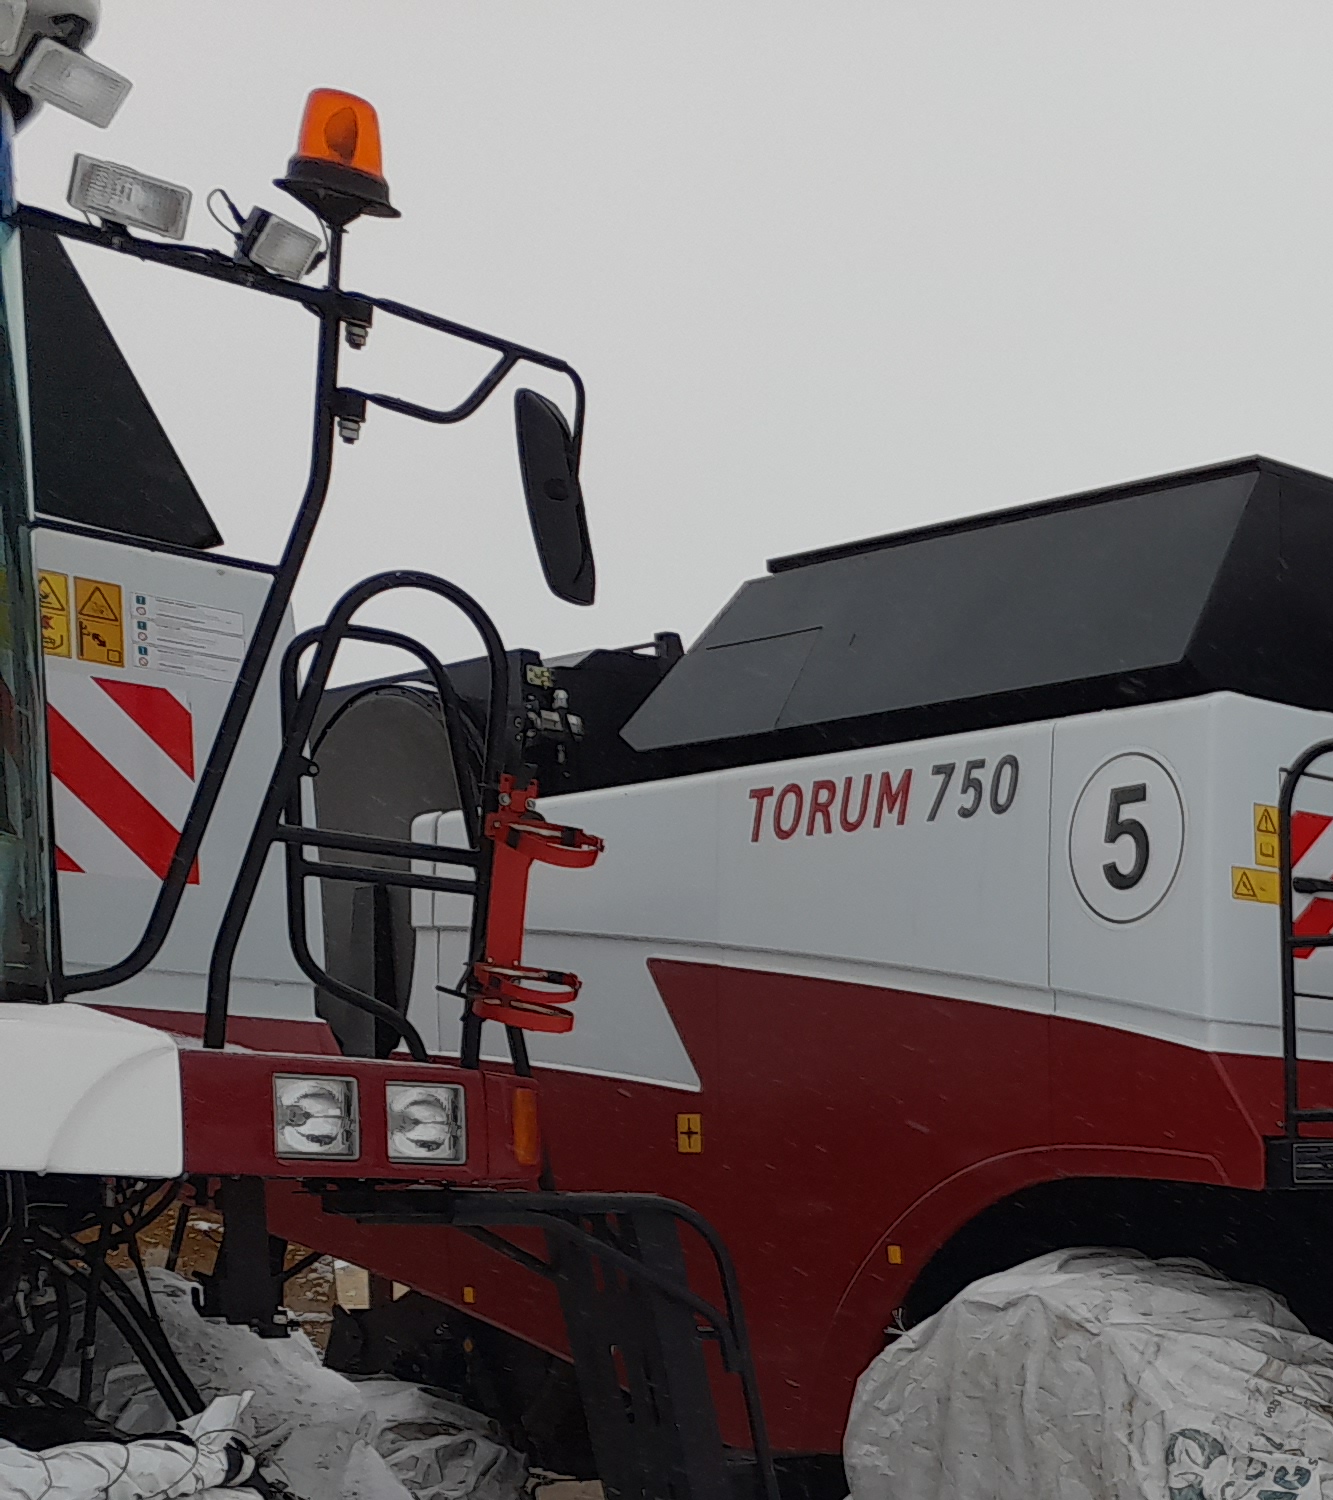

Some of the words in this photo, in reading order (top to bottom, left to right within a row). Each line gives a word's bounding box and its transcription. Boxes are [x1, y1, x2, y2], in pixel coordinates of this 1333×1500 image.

[749, 768, 913, 843] TORUM
[926, 754, 1019, 822] 750
[1102, 783, 1150, 891] 5
